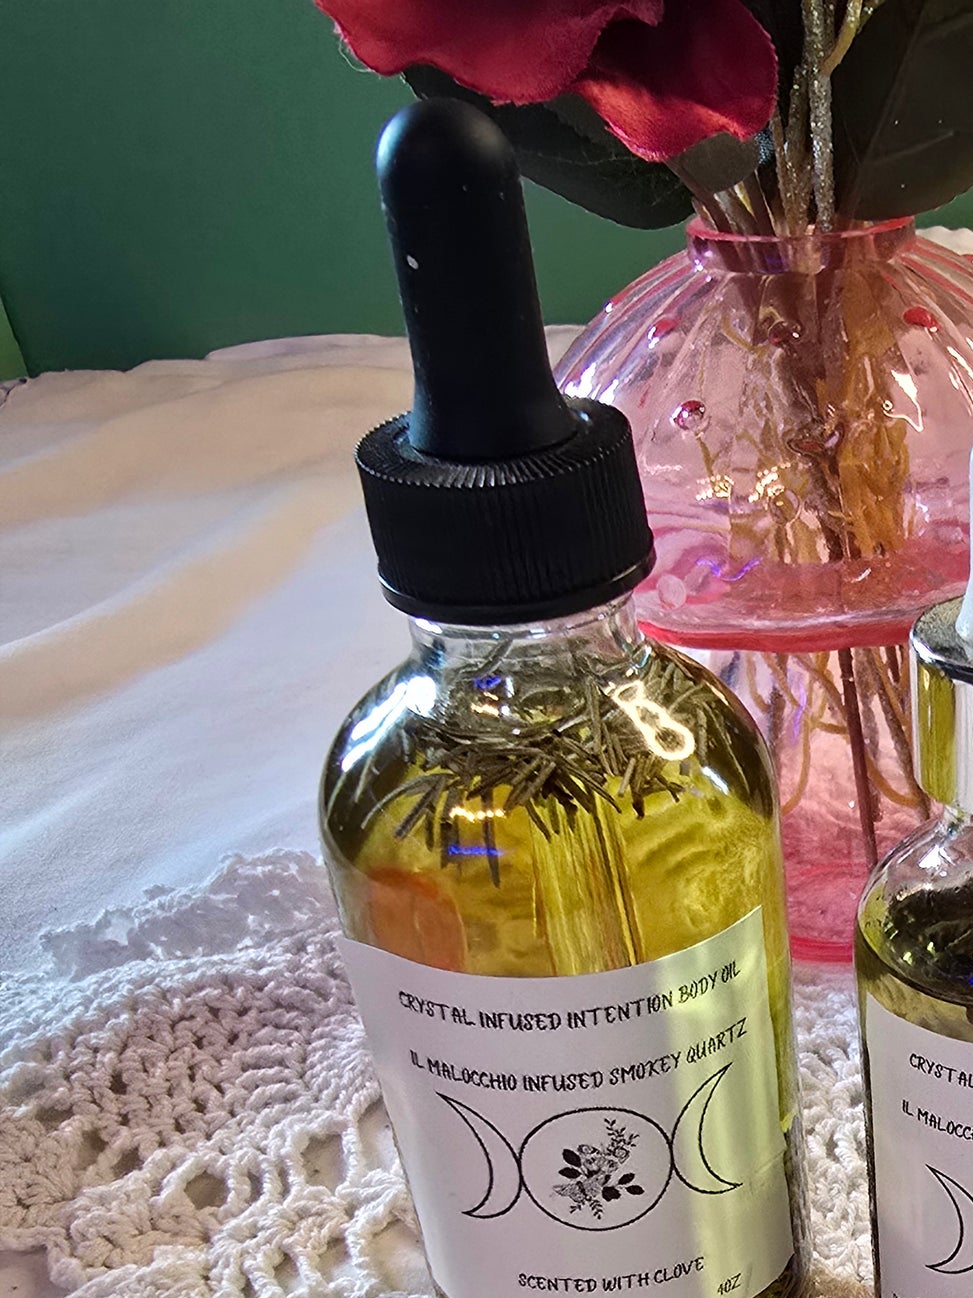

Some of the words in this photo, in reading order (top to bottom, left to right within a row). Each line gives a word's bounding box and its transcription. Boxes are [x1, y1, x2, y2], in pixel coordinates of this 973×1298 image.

[399, 990, 476, 1026] CRYSTAL
[479, 1011, 562, 1031] INFUSED
[567, 991, 673, 1029] INTENTION
[678, 972, 718, 1003] BODY
[721, 960, 741, 984] OIL
[410, 1049, 425, 1069] IL
[427, 1058, 517, 1091] MALOCCHIO
[523, 1072, 603, 1093] INFUSED
[609, 1051, 682, 1086] SMOKEY
[686, 1017, 748, 1063] QUARTZ
[902, 1099, 914, 1117] IL
[518, 1273, 597, 1293] SCENTED
[602, 1272, 650, 1292] WITH
[653, 1256, 704, 1284] CLOVE
